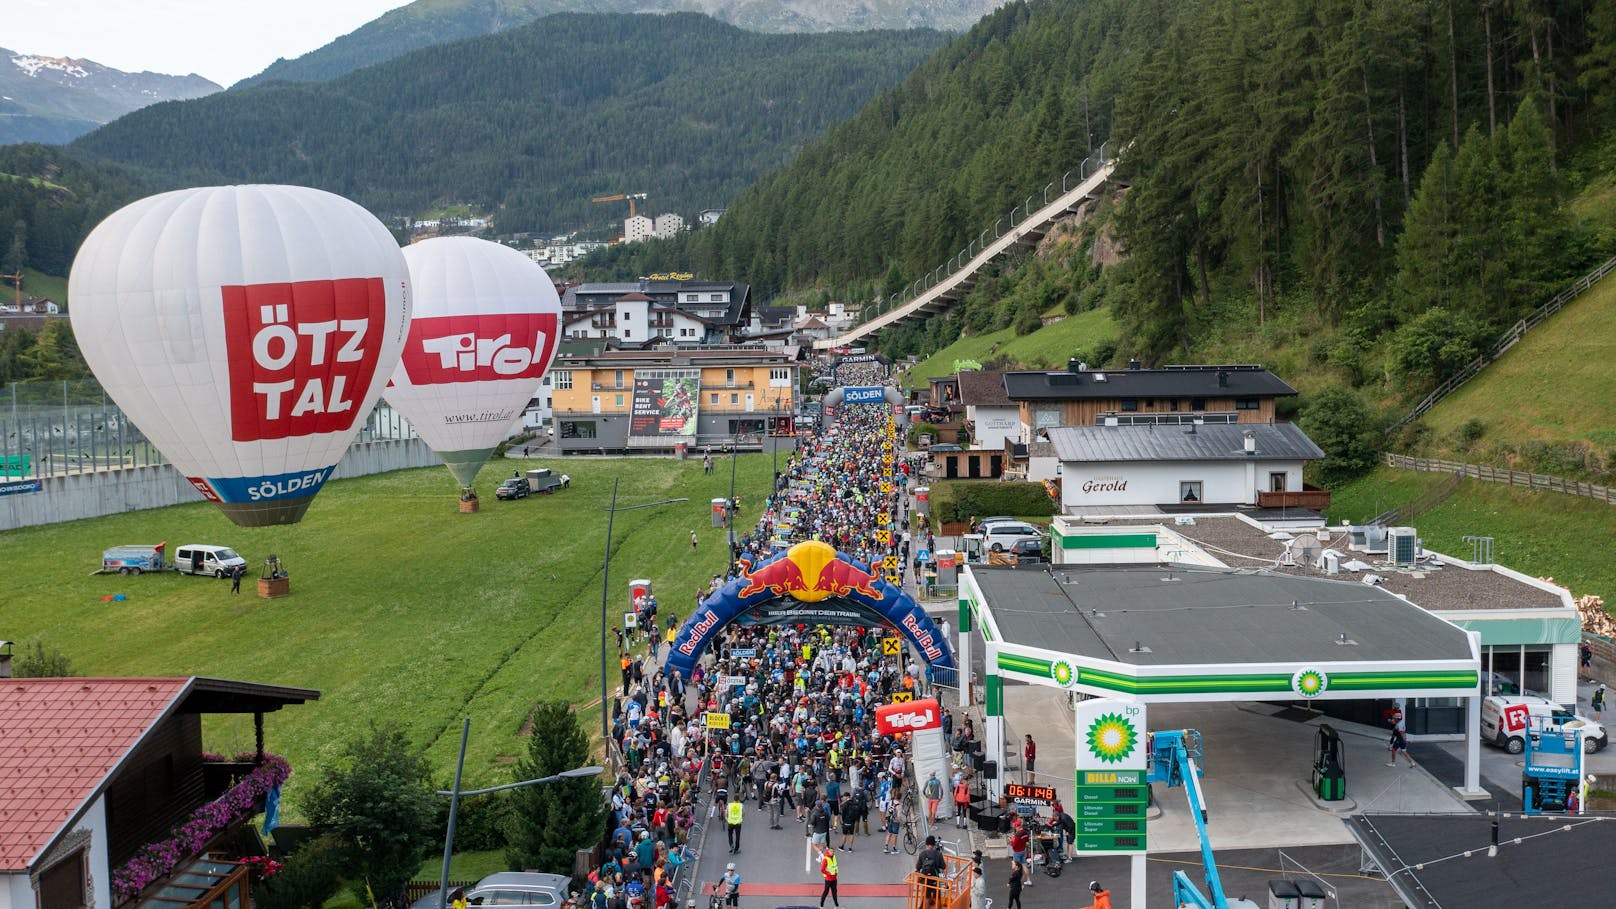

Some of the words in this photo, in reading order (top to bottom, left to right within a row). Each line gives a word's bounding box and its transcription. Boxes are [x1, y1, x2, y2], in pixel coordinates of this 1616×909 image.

[252, 303, 369, 371] ÖTZ
[422, 330, 547, 375] Tirol
[842, 355, 875, 363] GARMIN
[253, 375, 353, 420] TAL
[846, 389, 882, 401] SÖLDEN
[445, 408, 514, 424] www.tirol.at
[247, 469, 328, 500] SÖLDEN
[1082, 480, 1128, 494] Gerold
[679, 631, 703, 656] Red
[695, 610, 719, 635] Bull
[902, 614, 928, 640] Red
[919, 635, 943, 661] Bull
[885, 708, 934, 728] Tirol
[1125, 705, 1139, 716] bp
[701, 715, 707, 724] A
[1087, 773, 1117, 783] BILLA
[1528, 766, 1579, 776] www.easylift.at
[1014, 797, 1047, 806] GARMIN
